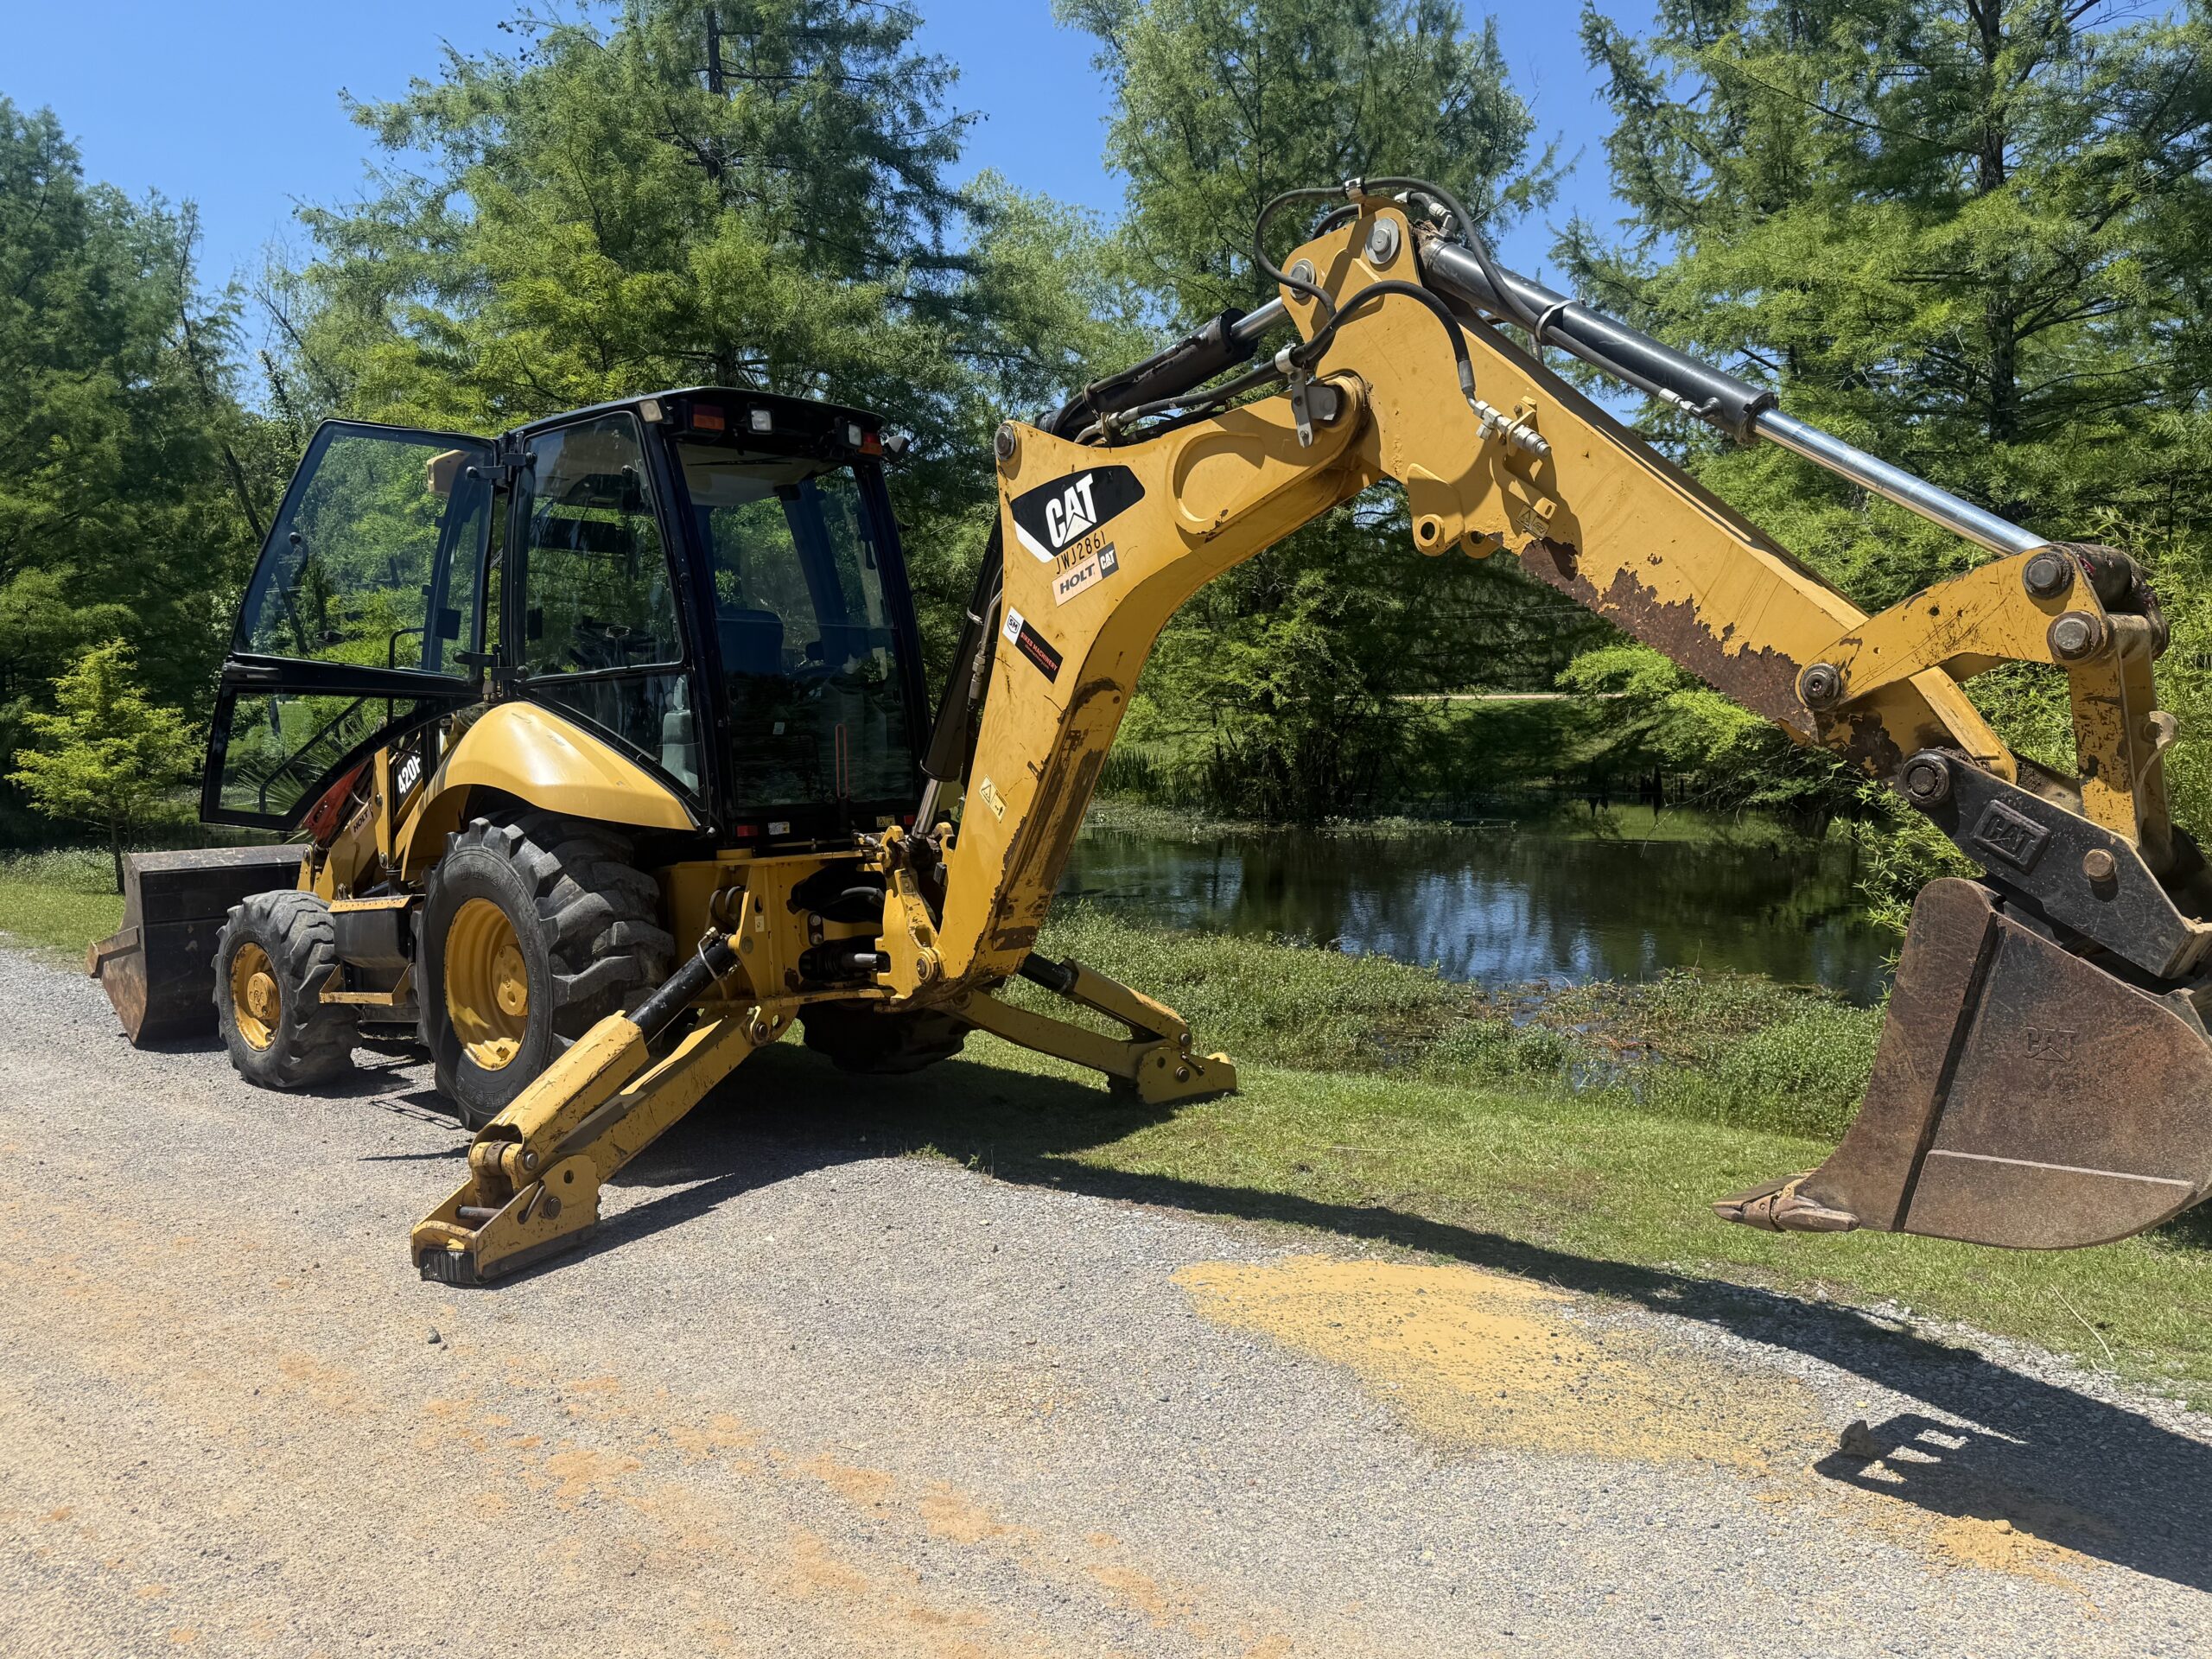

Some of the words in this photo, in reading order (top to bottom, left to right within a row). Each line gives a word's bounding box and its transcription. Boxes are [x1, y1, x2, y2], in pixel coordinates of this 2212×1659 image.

[1046, 474, 1097, 549] CAT
[1056, 531, 1107, 575] JWJ2861
[1059, 563, 1095, 594] HOLT
[1100, 550, 1115, 570] CAT
[1008, 619, 1018, 631] SM
[1033, 644, 1058, 671] MACHINERY
[353, 809, 369, 833] HOLT
[1981, 815, 2037, 860] CAT
[2020, 1027, 2081, 1063] CAT
